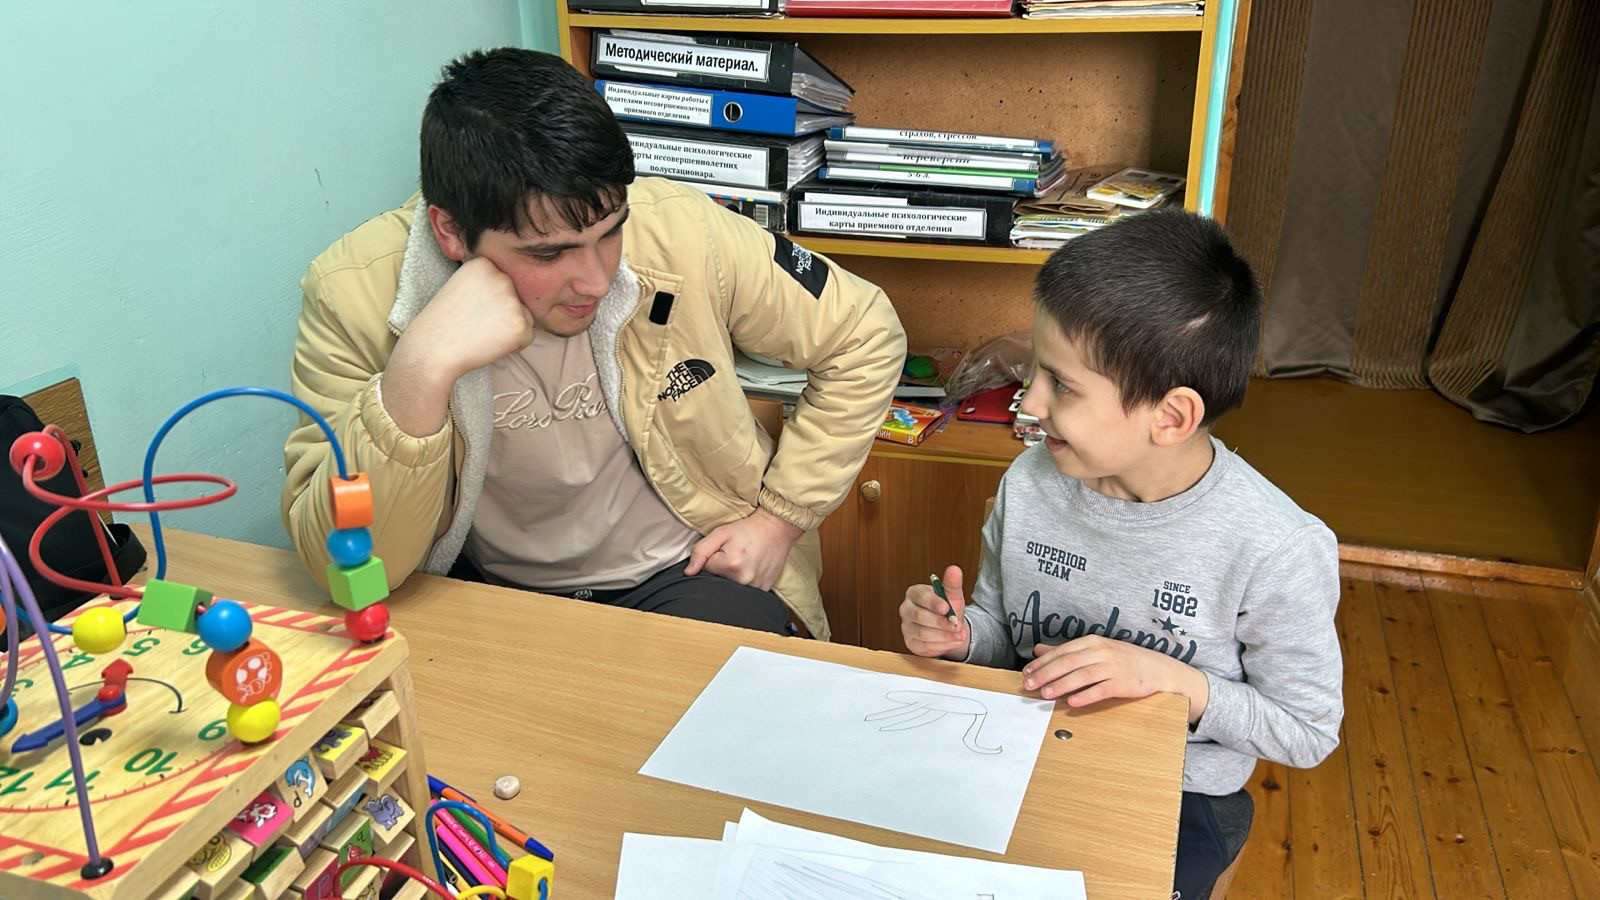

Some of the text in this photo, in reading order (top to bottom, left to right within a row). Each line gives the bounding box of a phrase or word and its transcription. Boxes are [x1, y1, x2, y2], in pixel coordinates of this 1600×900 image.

[605, 42, 758, 72] Методический материал.
[606, 96, 709, 113] родителями несовершеннолетних
[607, 86, 660, 98] Индивидуальные
[661, 93, 680, 102] карты
[681, 95, 705, 105] работы
[623, 107, 690, 120] приемного отделения
[653, 154, 738, 169] несовершеннолетних
[683, 146, 752, 159] психологические
[649, 164, 715, 178] полустационара.
[814, 207, 967, 222] Индивидуальные психологические
[828, 220, 953, 233] карты приемного отделения
[666, 361, 686, 382] THE
[657, 369, 693, 402] NORTH
[671, 377, 699, 403] FACE
[1026, 540, 1087, 571] SUPERIOR
[1037, 558, 1072, 582] TEAM
[1163, 581, 1191, 594] SINCE
[1151, 588, 1199, 618] 1982
[122, 637, 160, 656] 5
[62, 652, 95, 670] 4
[124, 748, 178, 776] 10
